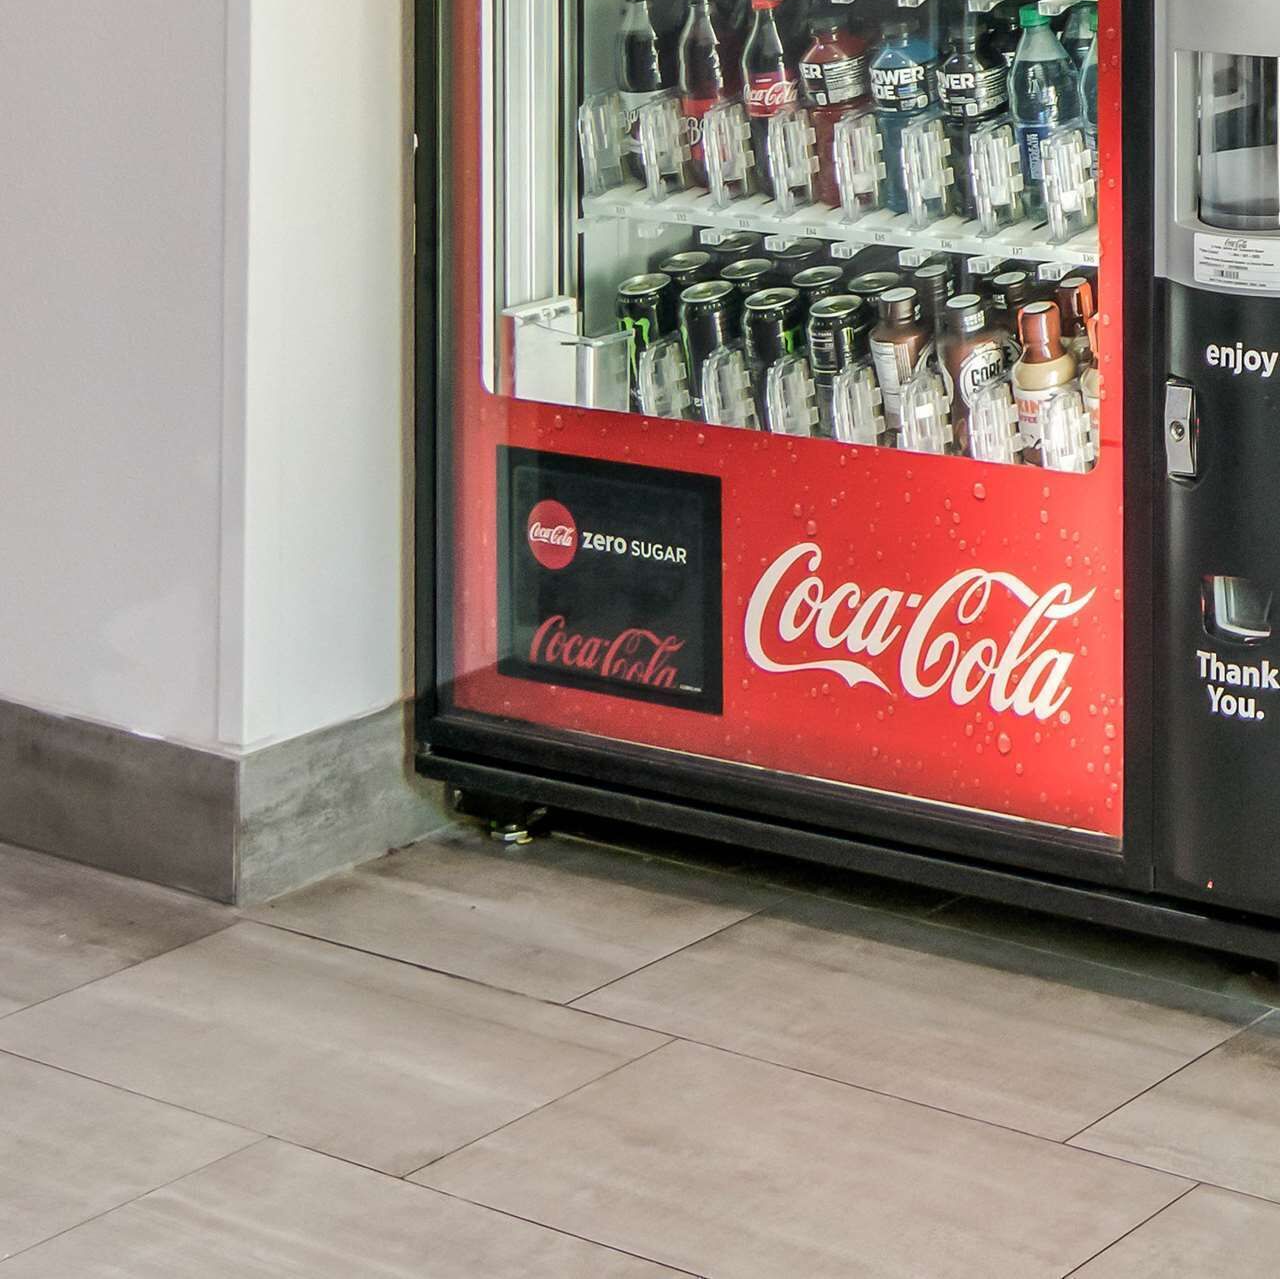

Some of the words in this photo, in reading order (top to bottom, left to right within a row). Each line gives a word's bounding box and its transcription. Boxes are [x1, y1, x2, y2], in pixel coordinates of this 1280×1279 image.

[1206, 342, 1279, 377] enjoy
[529, 522, 577, 547] Coca-Cola
[582, 531, 627, 554] zero
[631, 540, 687, 565] SUGAR
[744, 541, 1097, 722] Coca-Cola
[1196, 650, 1280, 689] Thank
[1208, 684, 1265, 720] You.
